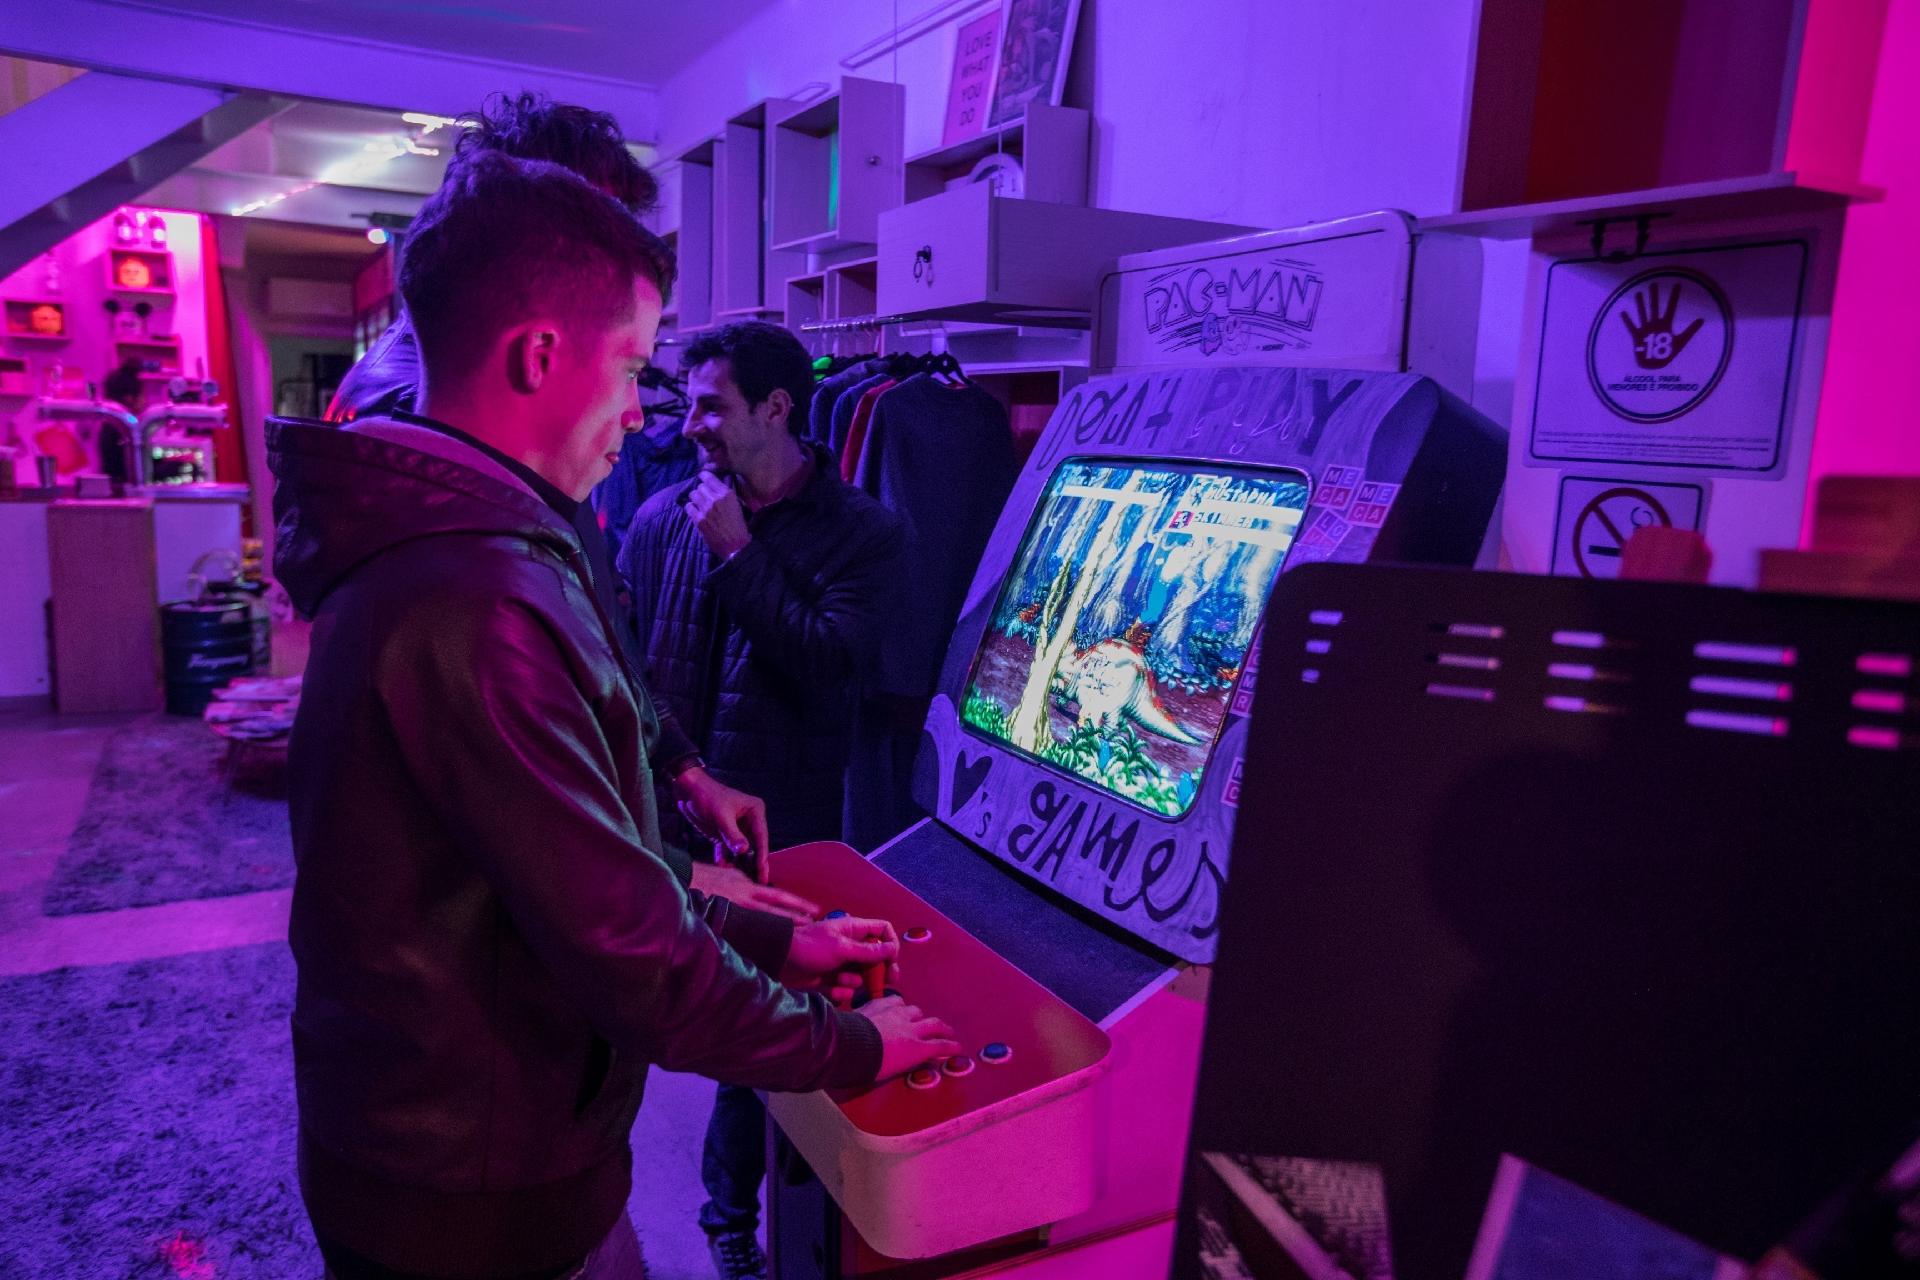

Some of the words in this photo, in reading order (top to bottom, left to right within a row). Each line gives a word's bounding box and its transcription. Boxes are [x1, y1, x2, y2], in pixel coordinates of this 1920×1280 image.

[964, 31, 993, 56] LOVE
[961, 55, 991, 80] WHAT
[961, 82, 982, 102] YOU
[959, 107, 976, 126] DO
[1143, 267, 1324, 335] PAC-MAN
[1635, 332, 1673, 359] -18
[1325, 470, 1357, 484] ME
[1319, 488, 1346, 503] CA
[1360, 486, 1393, 500] ME
[1353, 505, 1380, 521] CA
